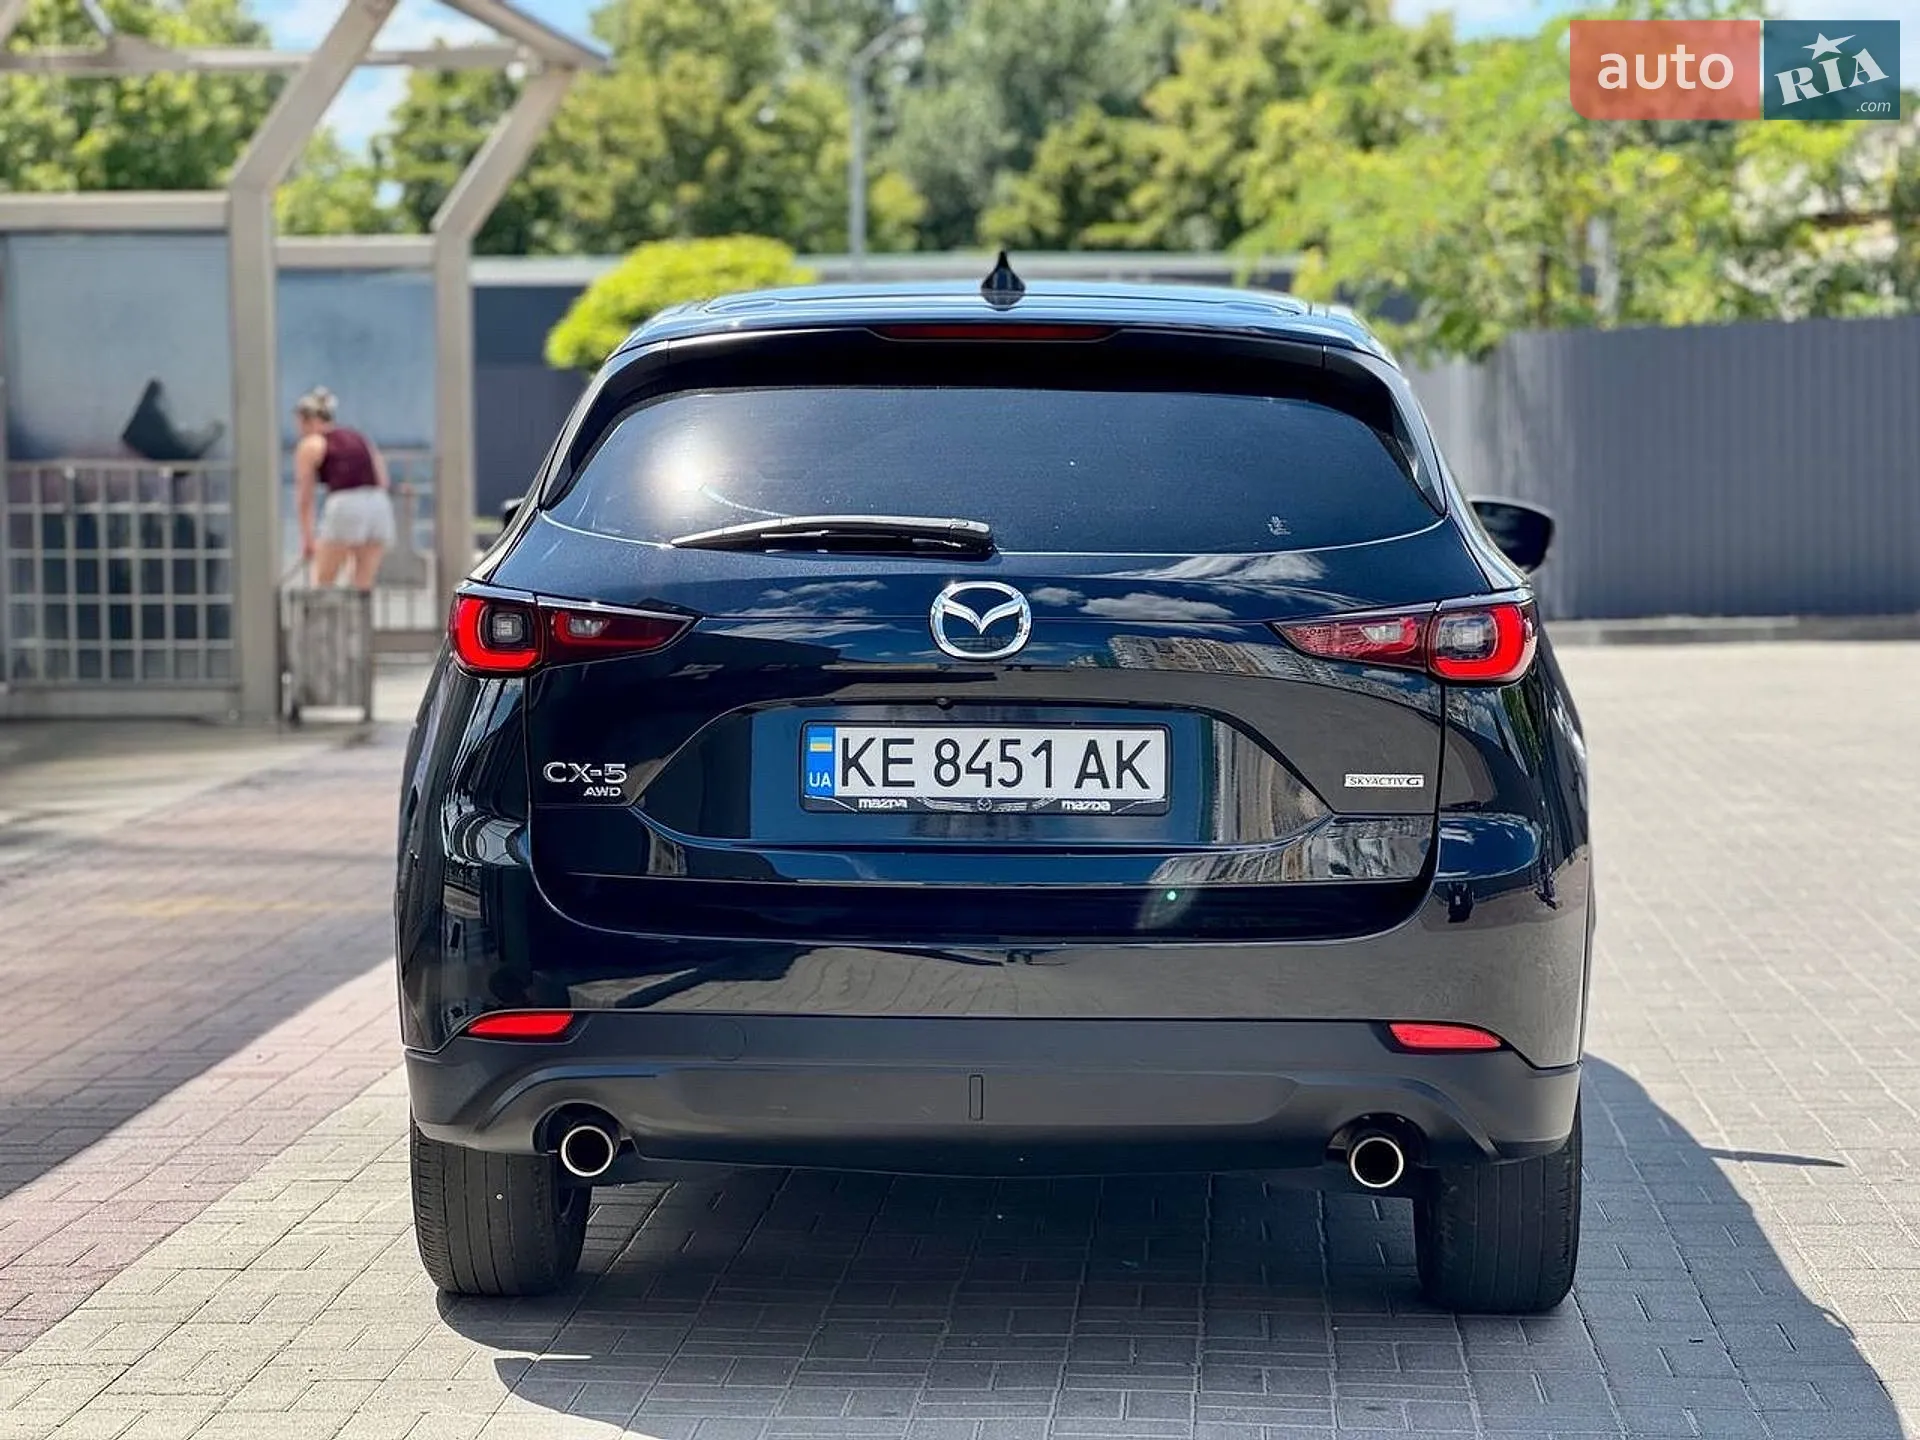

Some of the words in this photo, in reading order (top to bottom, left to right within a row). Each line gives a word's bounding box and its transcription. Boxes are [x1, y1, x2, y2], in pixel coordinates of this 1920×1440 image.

[841, 737, 915, 788] KE
[934, 738, 1053, 789] 8451
[1074, 739, 1151, 790] AK
[543, 762, 627, 784] CX-5
[809, 773, 832, 788] UA
[583, 787, 621, 797] AWD
